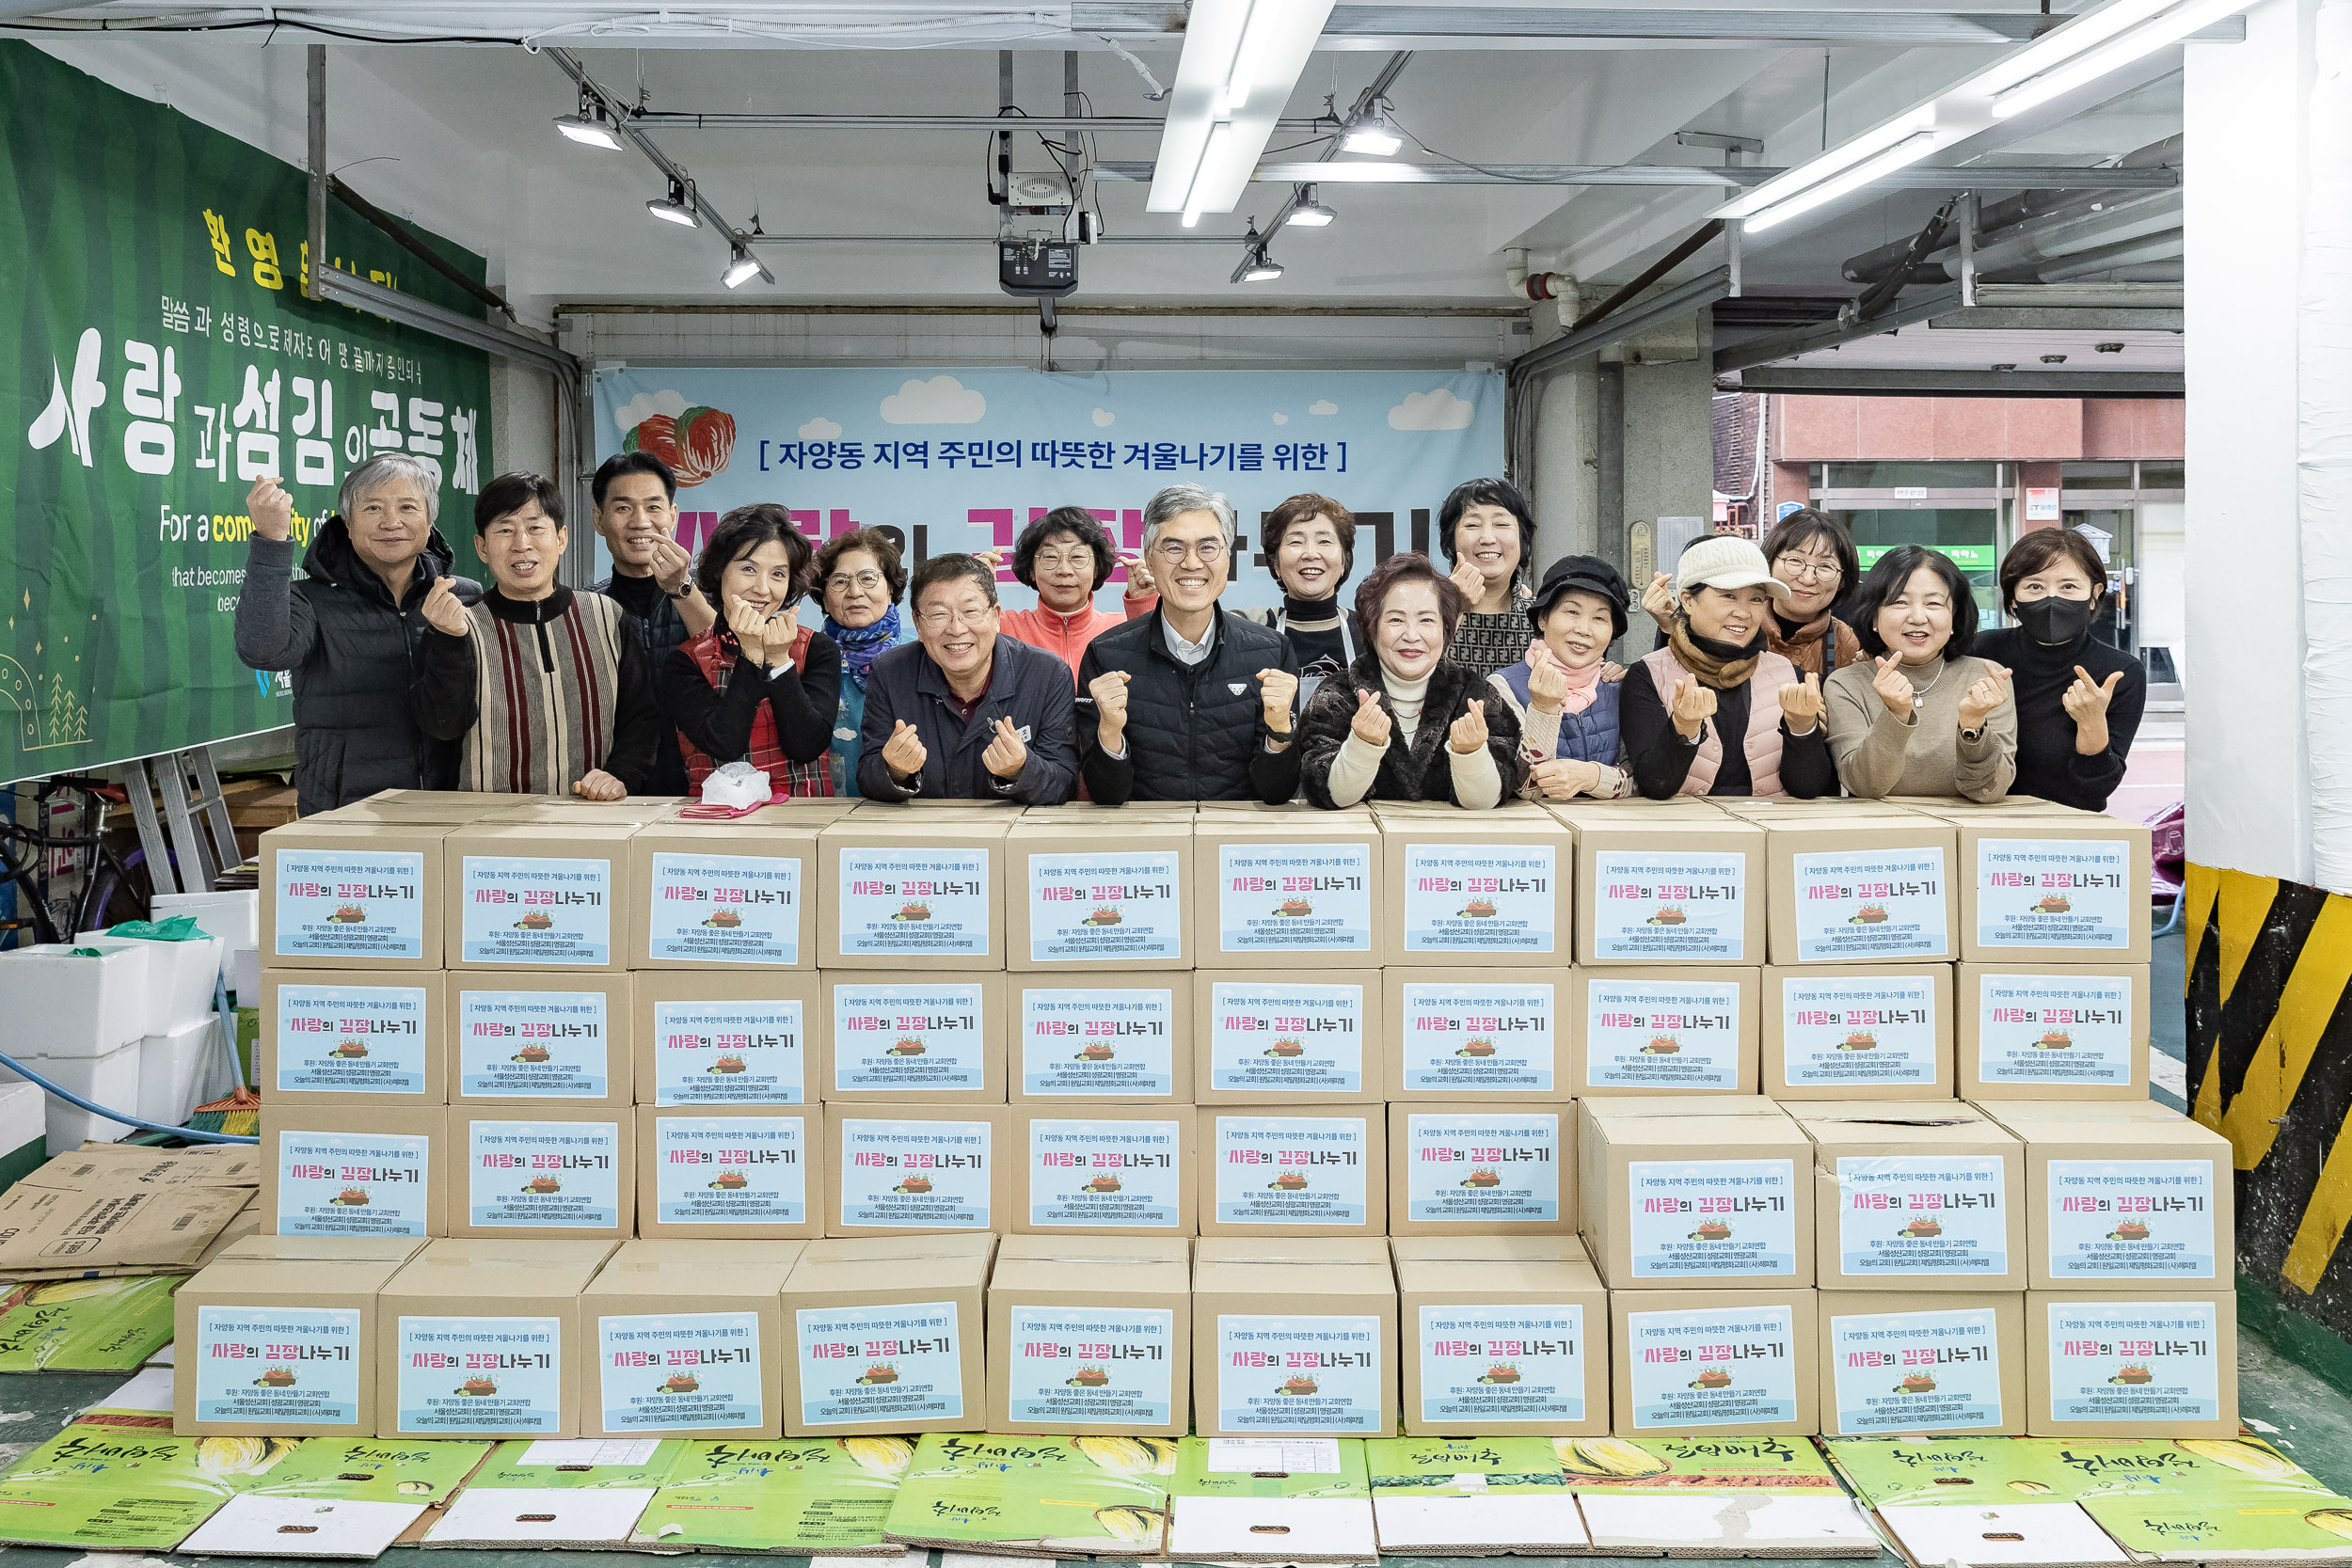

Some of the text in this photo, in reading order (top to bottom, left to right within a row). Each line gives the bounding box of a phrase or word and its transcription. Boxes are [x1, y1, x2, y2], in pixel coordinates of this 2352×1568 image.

[161, 295, 213, 338] 말씀과
[220, 312, 280, 352] 성령으로
[778, 442, 865, 469] 자양동
[873, 441, 930, 470] 지역
[938, 441, 1022, 469] 주민의
[1031, 441, 1116, 470] 따뜻한
[1123, 443, 1264, 471] 겨울나기를
[1272, 443, 1328, 471] 위한
[160, 504, 192, 542] For
[197, 515, 209, 542] a
[172, 566, 195, 587] that
[852, 880, 979, 895] 사랑의 김장나누기
[1232, 876, 1361, 892] 사랑의 김장나누기
[1418, 878, 1546, 893] 사랑의 김장나누기
[1991, 872, 2121, 888] 사랑의 김장나누기
[289, 882, 414, 899] 사랑의 김장나누기
[475, 889, 601, 906] 사랑의 김장나누기
[664, 885, 791, 905] 사랑의 김장나누기
[1042, 884, 1170, 901] 사랑의 김장나누기
[1609, 884, 1736, 899] 사랑의 김장나누기
[1808, 880, 1936, 900] 사랑의 김장나누기
[847, 1016, 974, 1031] 사랑의 김장나누기
[1601, 1013, 1730, 1030] 사랑의 김장나누기
[1796, 1009, 1926, 1025] 사랑의 김장나누기
[1993, 1007, 2122, 1024] 사랑의 김장나누기
[291, 1018, 417, 1034] 사랑의 김장나누기
[472, 1022, 597, 1037] 사랑의 김장나누기
[1035, 1021, 1163, 1036] 사랑의 김장나누기
[1225, 1016, 1353, 1032] 사랑의 김장나누기
[1416, 1017, 1545, 1031] 사랑의 김장나누기
[668, 1034, 794, 1049] 사랑의 김장나누기
[483, 1153, 609, 1169] 사랑의 김장나누기
[669, 1149, 796, 1164] 사랑의 김장나누기
[854, 1152, 981, 1168] 사랑의 김장나누기
[1042, 1152, 1170, 1167] 사랑의 김장나누기
[1229, 1149, 1357, 1165] 사랑의 김장나누기
[1421, 1148, 1549, 1162] 사랑의 김장나누기
[292, 1164, 419, 1183] 사랑의 김장나누기
[1645, 1196, 1785, 1213] 사랑의 김장나누기
[1852, 1193, 1995, 1209] 사랑의 김장나누기
[2062, 1196, 2203, 1212] 사랑의 김장나누기
[212, 1342, 350, 1361] 사랑의 김장나누기
[812, 1338, 950, 1359] 사랑의 김장나누기
[1025, 1342, 1162, 1360] 사랑의 김장나누기
[1434, 1339, 1574, 1356] 사랑의 김장나누기
[1644, 1342, 1784, 1364] 사랑의 김장나누기
[2063, 1340, 2207, 1356] 사랑의 김장나누기
[412, 1353, 550, 1369] 사랑의 김장나누기
[613, 1347, 751, 1368] 사랑의 김장나누기
[1232, 1352, 1371, 1368] 사랑의 김장나누기
[1848, 1345, 1989, 1368] 사랑의 김장나누기
[705, 1444, 830, 1468] 절임배추
[940, 1437, 1068, 1463] 절임배추
[1409, 1449, 1503, 1465] 절임배추
[1661, 1436, 1798, 1462] 절임배추
[2059, 1450, 2201, 1477] 절임배추
